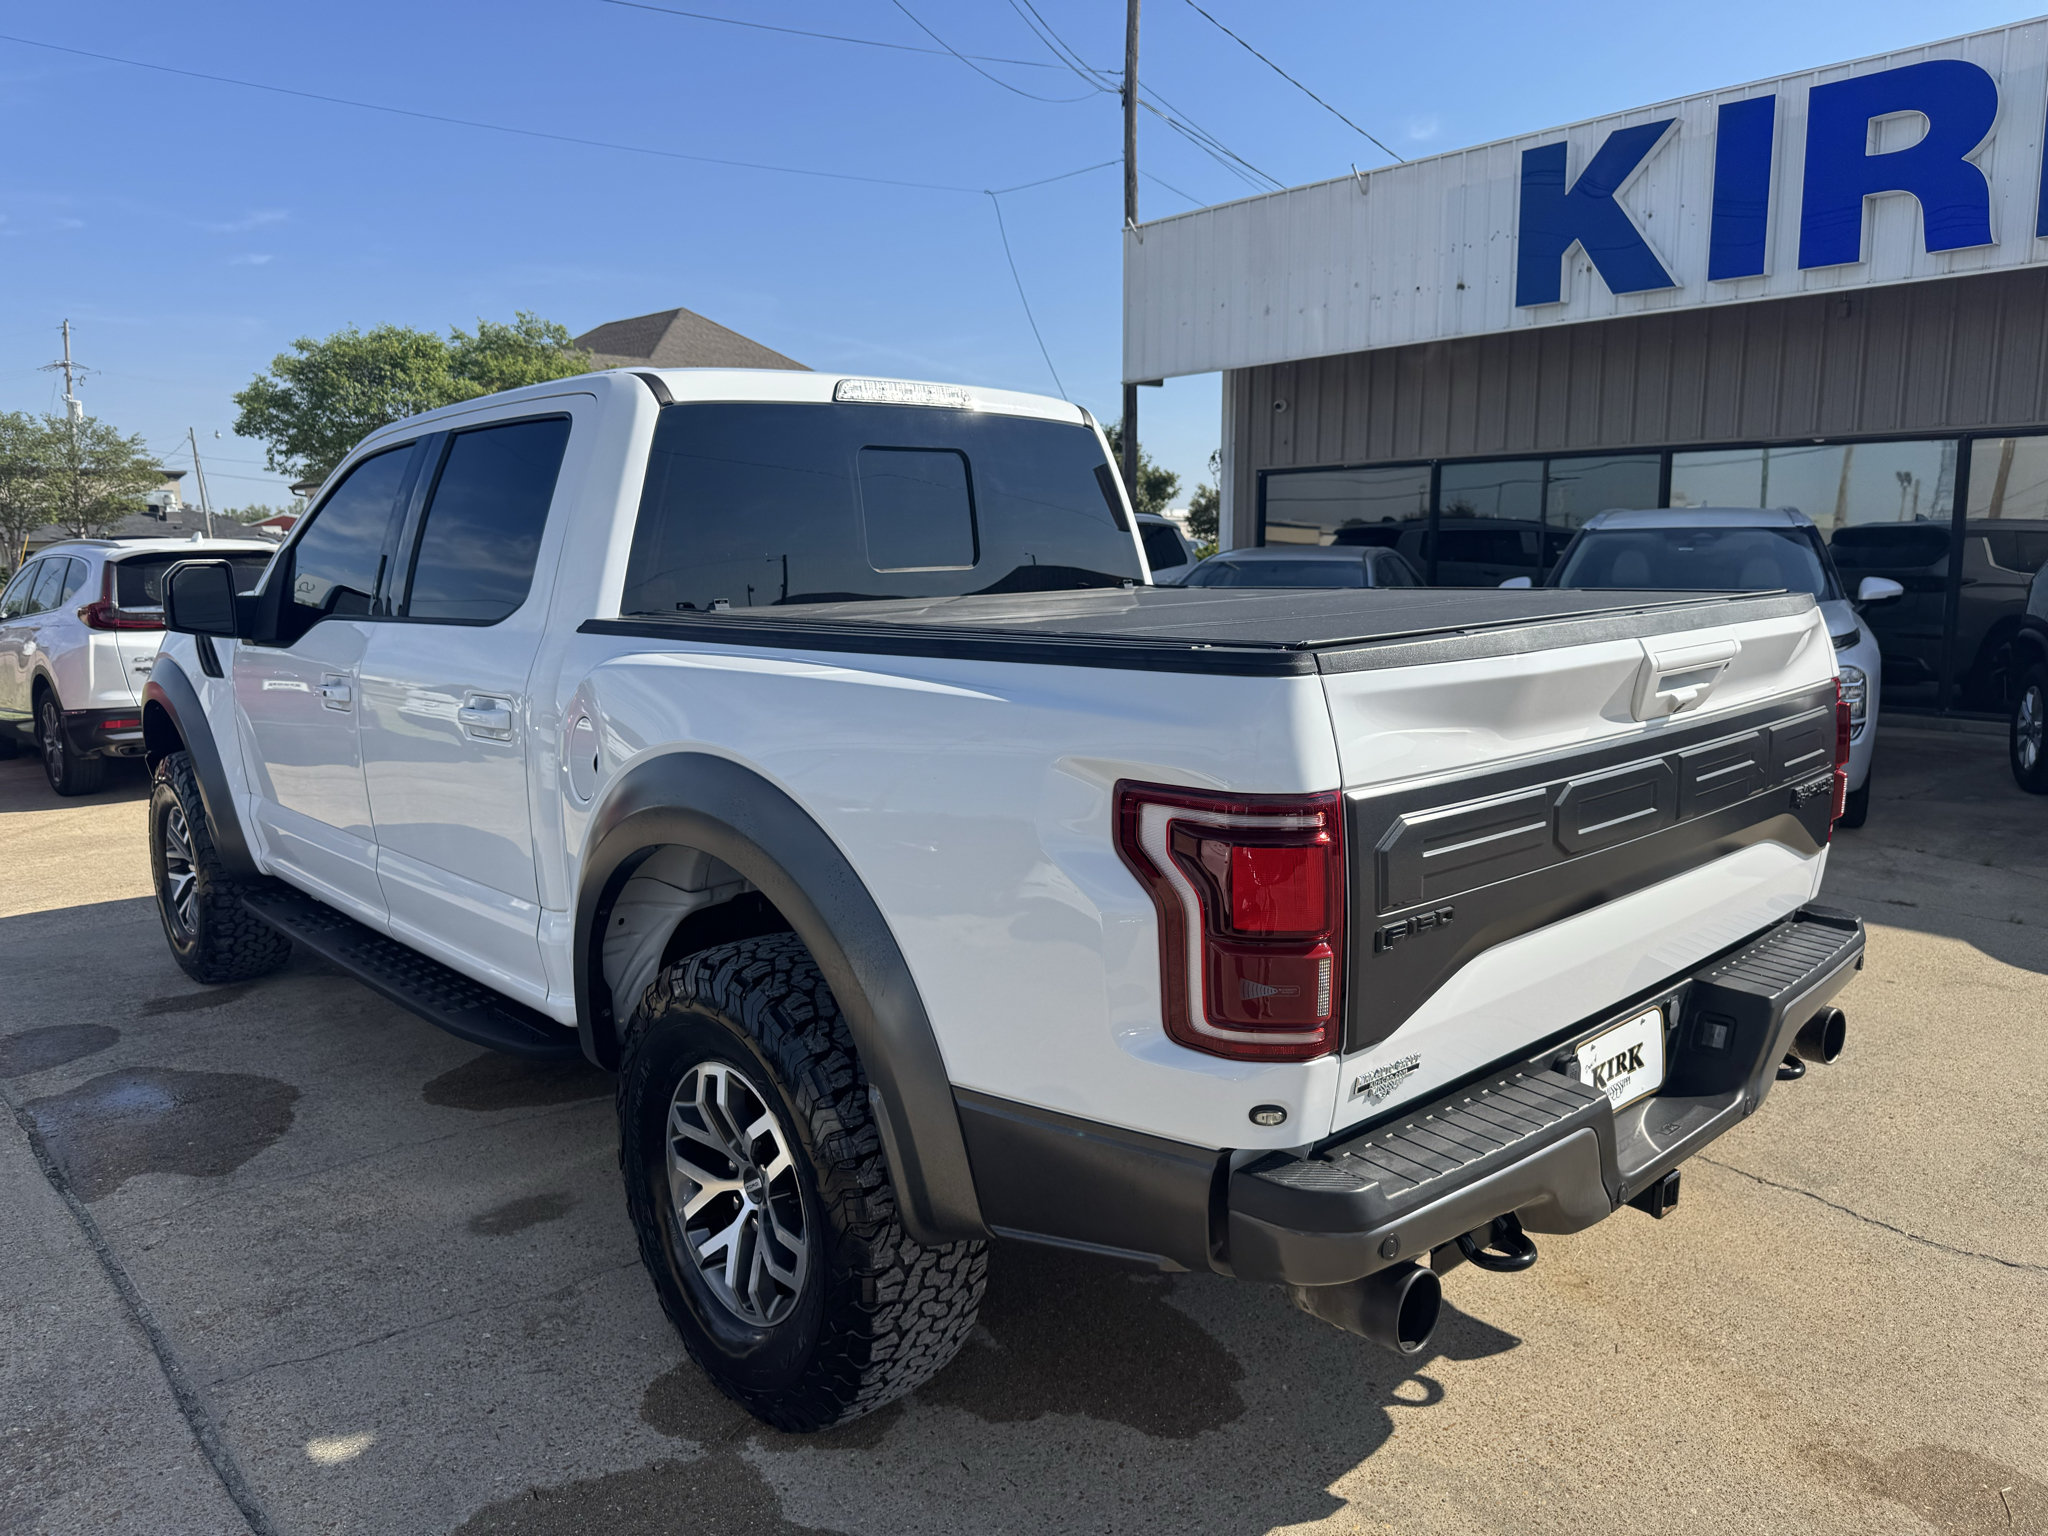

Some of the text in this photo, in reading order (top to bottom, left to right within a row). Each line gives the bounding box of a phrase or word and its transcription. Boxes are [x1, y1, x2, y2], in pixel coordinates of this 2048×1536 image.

[1516, 58, 2048, 308] KIR
[1374, 705, 1832, 914] FORD
[1592, 1042, 1645, 1090] KIRK
